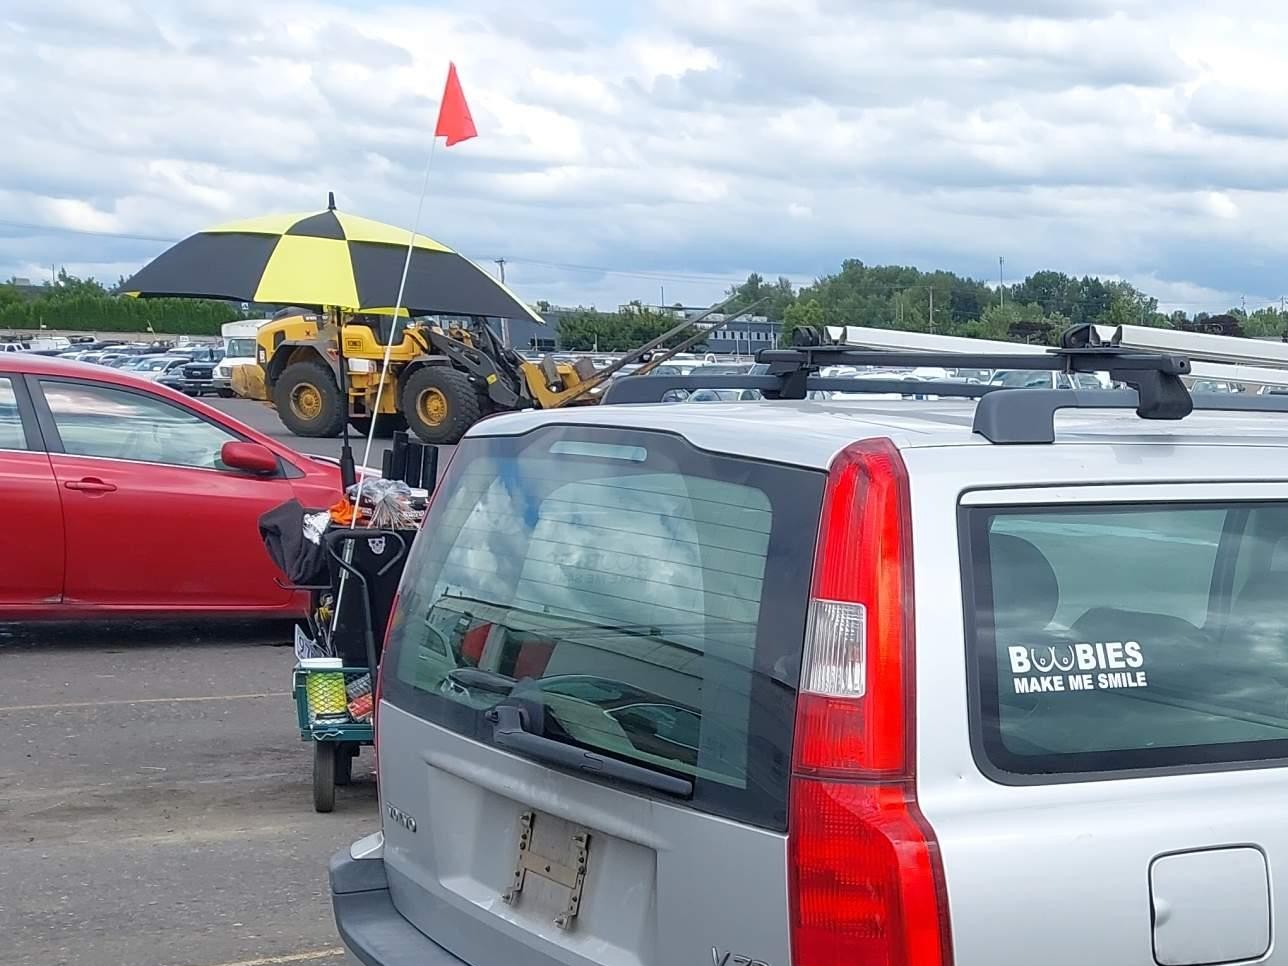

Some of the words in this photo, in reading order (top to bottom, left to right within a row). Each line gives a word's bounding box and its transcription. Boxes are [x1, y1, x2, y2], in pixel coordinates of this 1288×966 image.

[1014, 675, 1064, 693] MAKE
[1068, 674, 1094, 691] ME
[1098, 672, 1147, 688] SMILE
